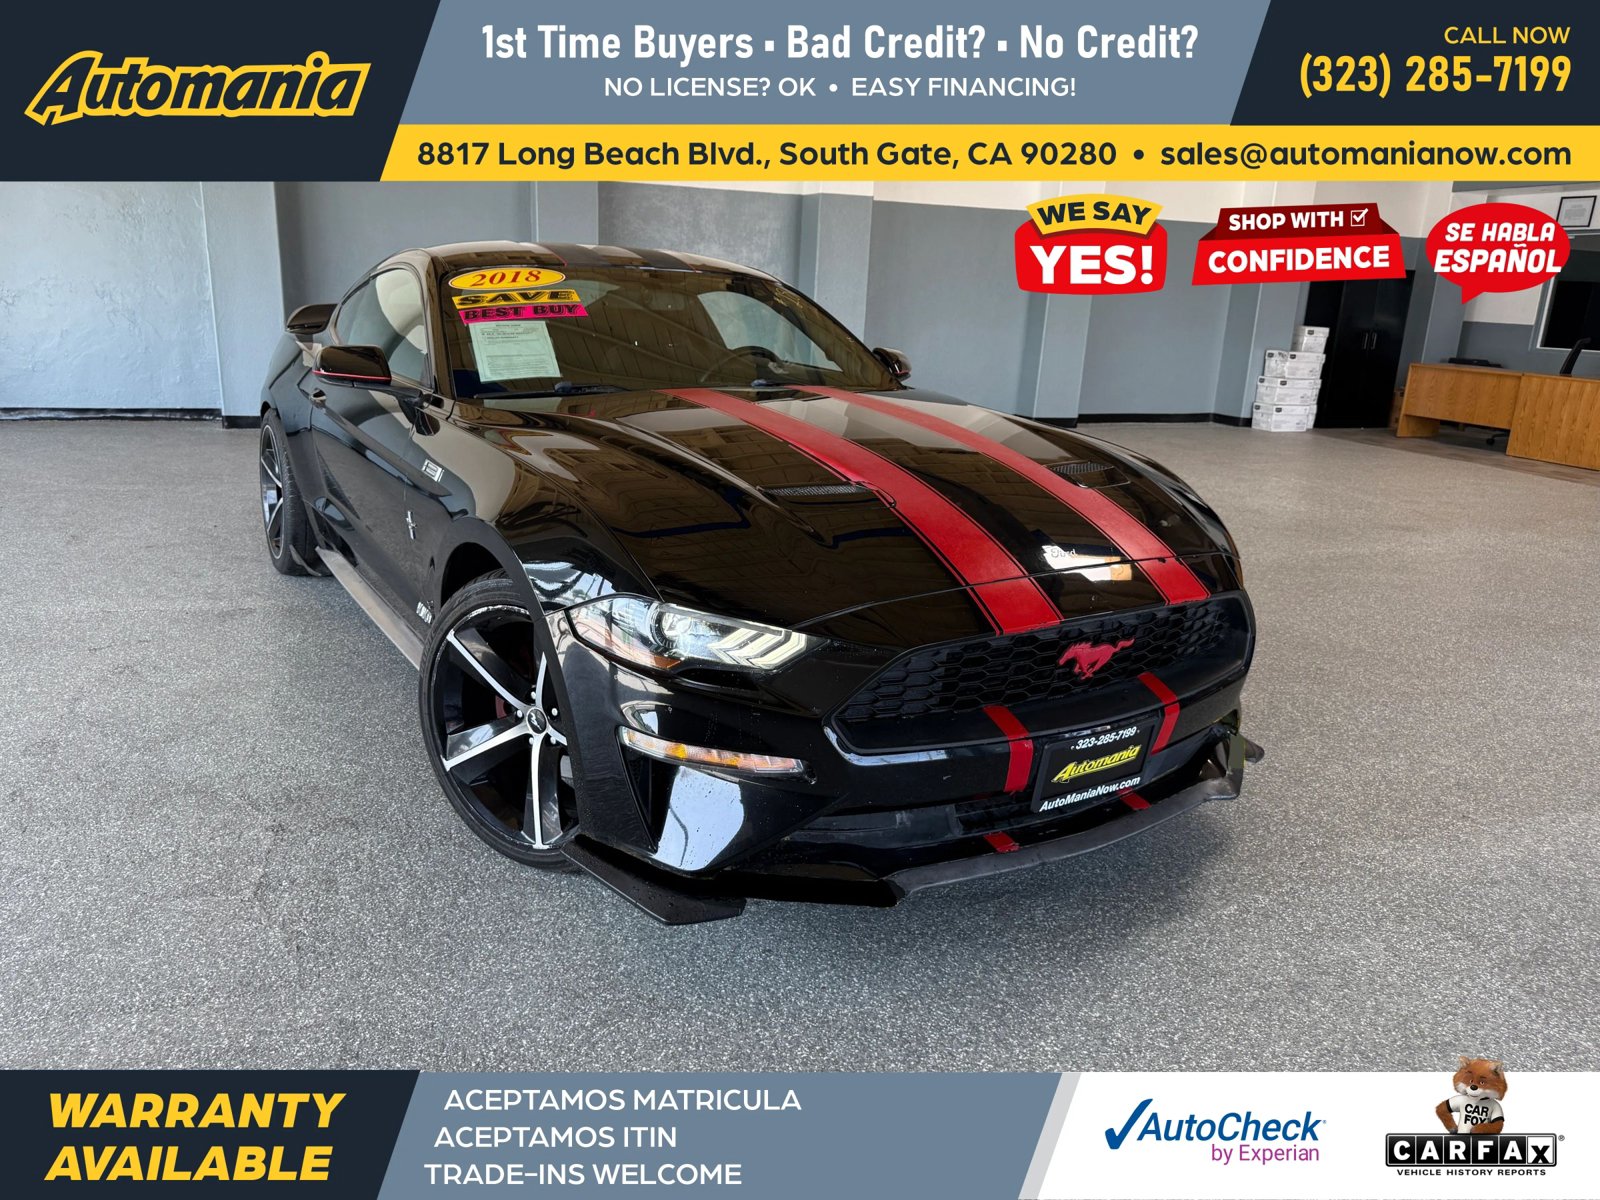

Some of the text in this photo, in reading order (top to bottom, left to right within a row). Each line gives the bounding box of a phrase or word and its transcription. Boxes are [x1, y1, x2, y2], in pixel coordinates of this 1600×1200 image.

[470, 269, 542, 287] 2018
[457, 291, 574, 306] SAVE
[464, 304, 580, 321] BEST BUY
[1075, 726, 1137, 750] 323-285-7199
[1051, 744, 1142, 783] Automania
[1039, 776, 1141, 812] AutoManiaNow.com
